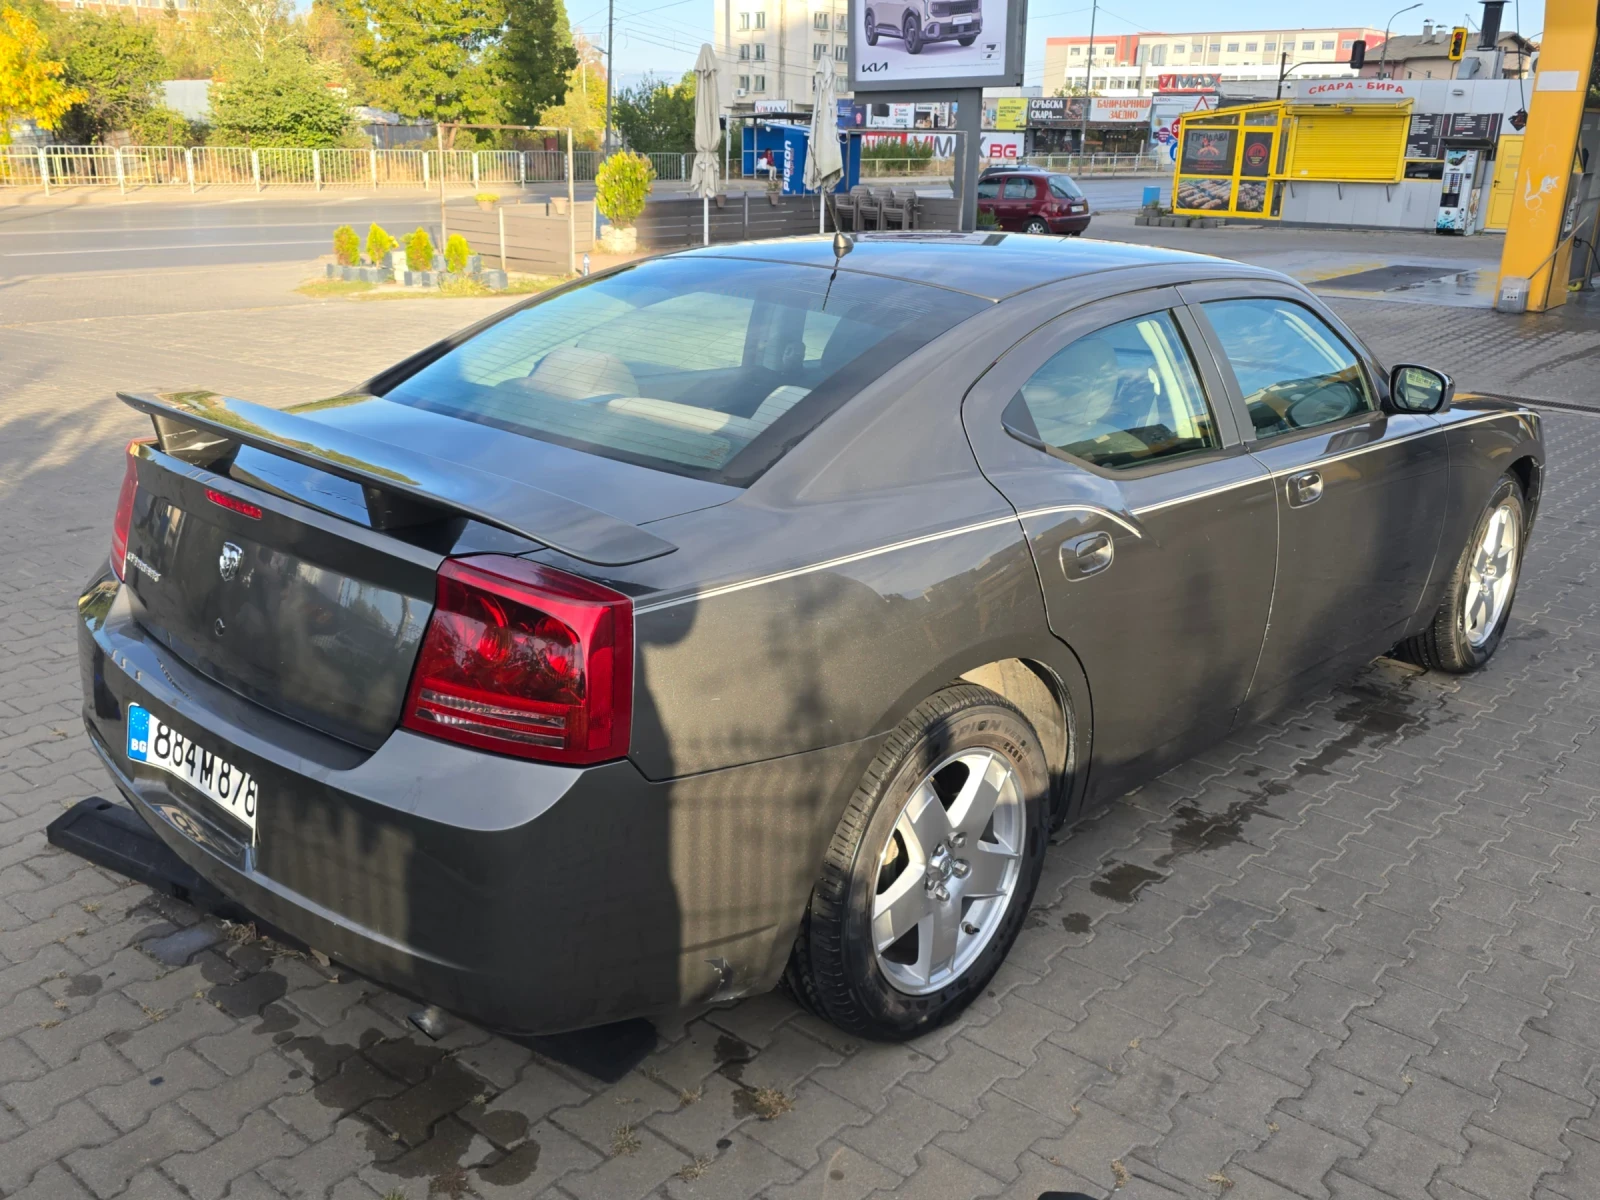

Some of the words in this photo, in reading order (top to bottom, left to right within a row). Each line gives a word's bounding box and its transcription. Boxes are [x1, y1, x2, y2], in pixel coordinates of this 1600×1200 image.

[861, 62, 889, 73] KIA
[1158, 74, 1222, 89] VIMAX
[1308, 82, 1354, 95] СКАРА
[1366, 81, 1404, 94] БИРА
[1031, 99, 1064, 109] СРЪБСКА
[1030, 110, 1053, 119] СКАРА
[1108, 110, 1139, 120] ЗАЕДНО
[783, 139, 792, 192] PIGEON
[131, 738, 147, 753] BG
